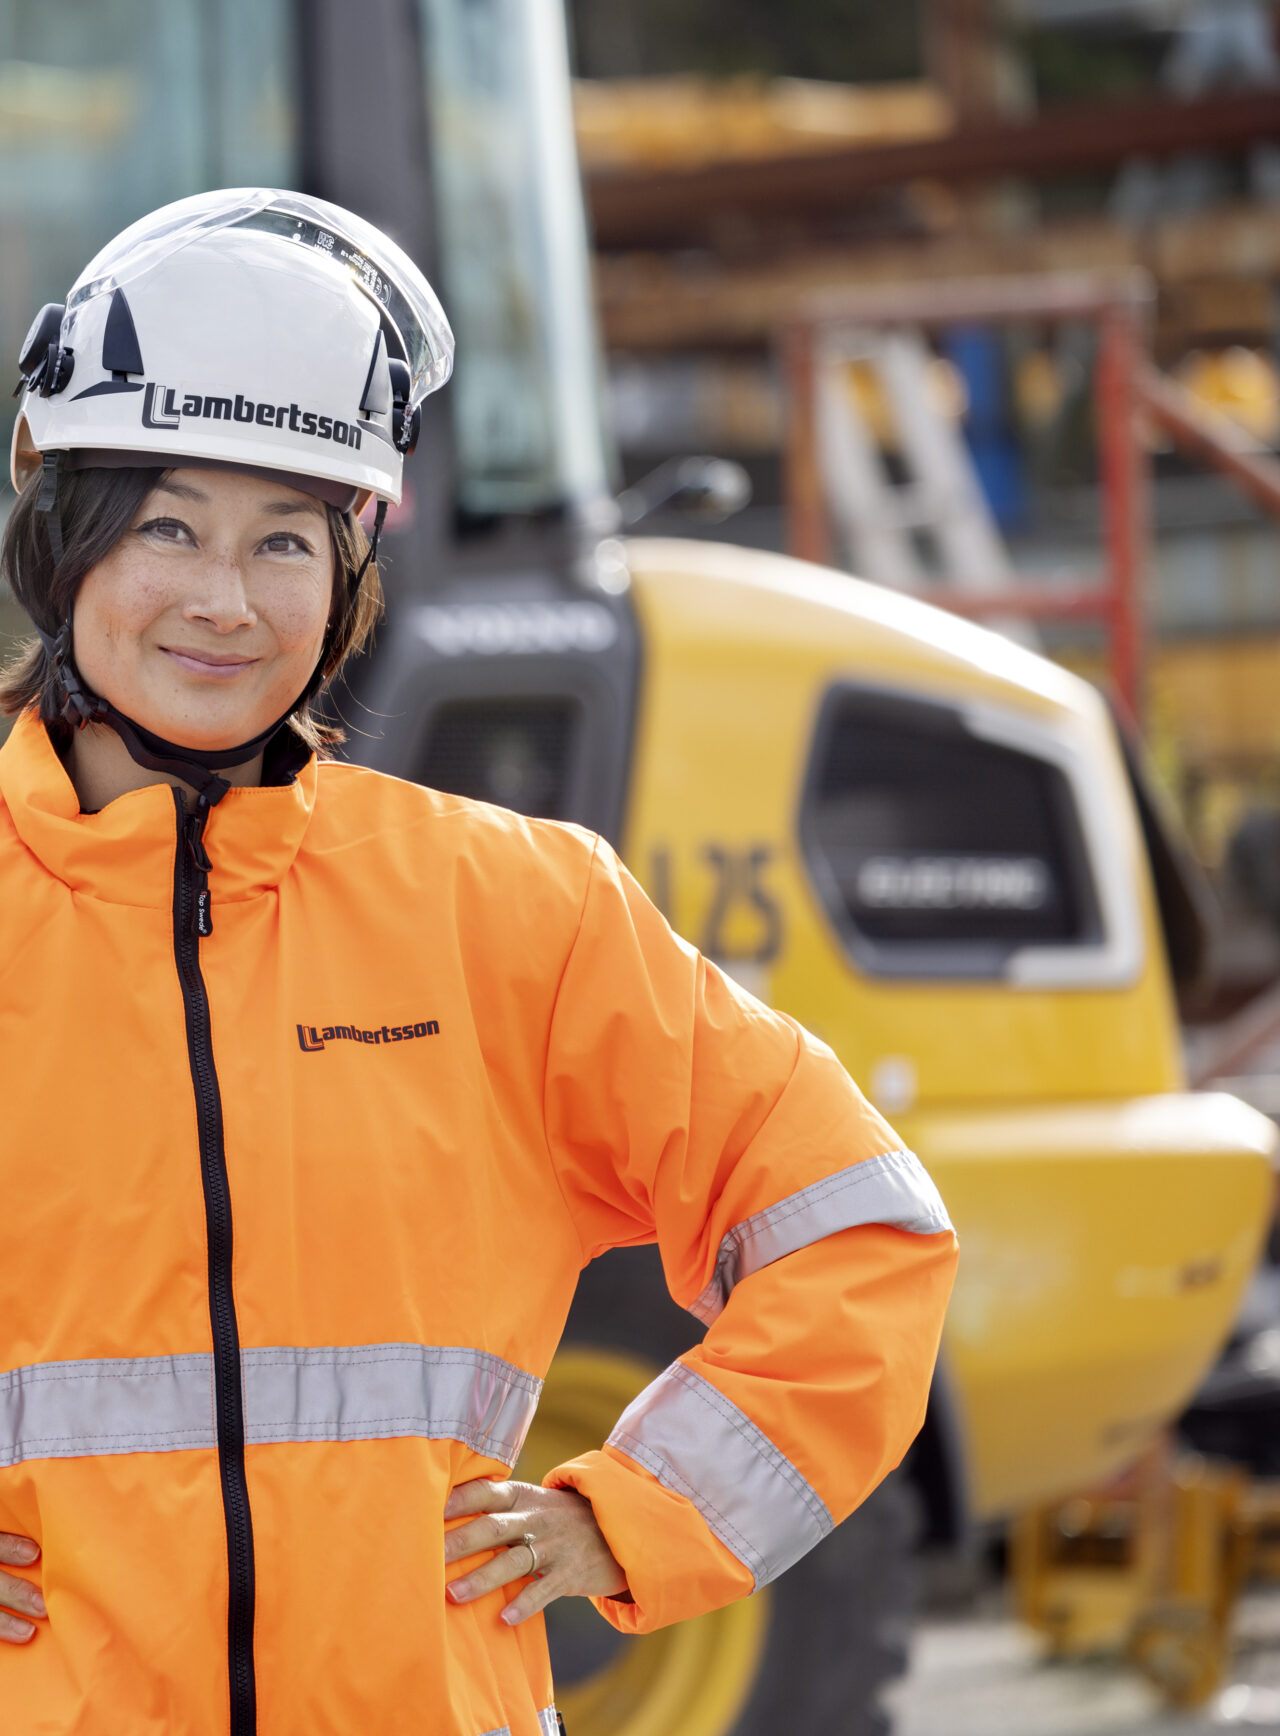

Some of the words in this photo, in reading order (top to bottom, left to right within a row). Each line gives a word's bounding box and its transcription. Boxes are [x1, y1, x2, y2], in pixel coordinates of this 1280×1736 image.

[141, 382, 362, 451] Lambertsson
[198, 894, 206, 907] Top
[296, 1020, 441, 1052] Lambertsson
